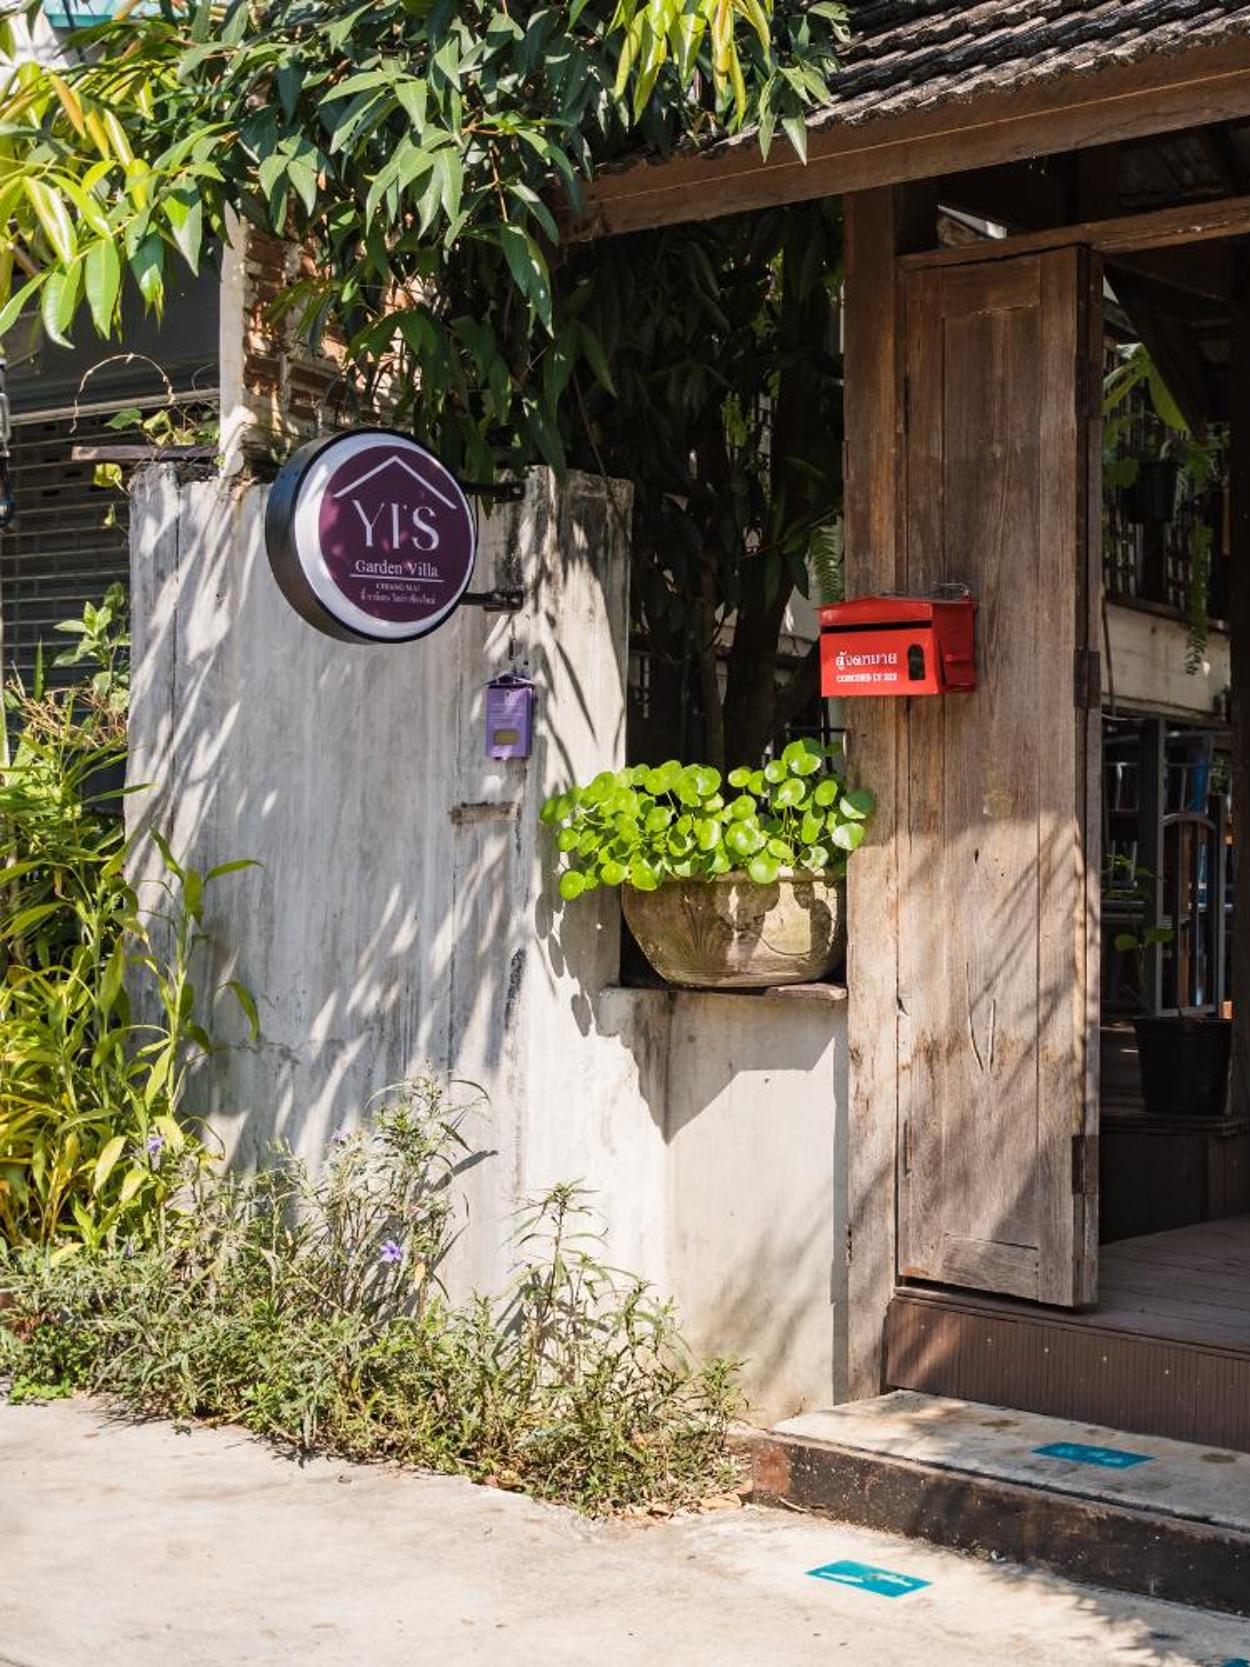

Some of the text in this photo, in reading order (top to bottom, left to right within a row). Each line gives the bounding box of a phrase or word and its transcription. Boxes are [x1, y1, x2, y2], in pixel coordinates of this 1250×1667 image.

[352, 500, 440, 551] YI'S
[355, 559, 439, 577] Garden Villa
[835, 651, 898, 671] ตู้จดหมาย
